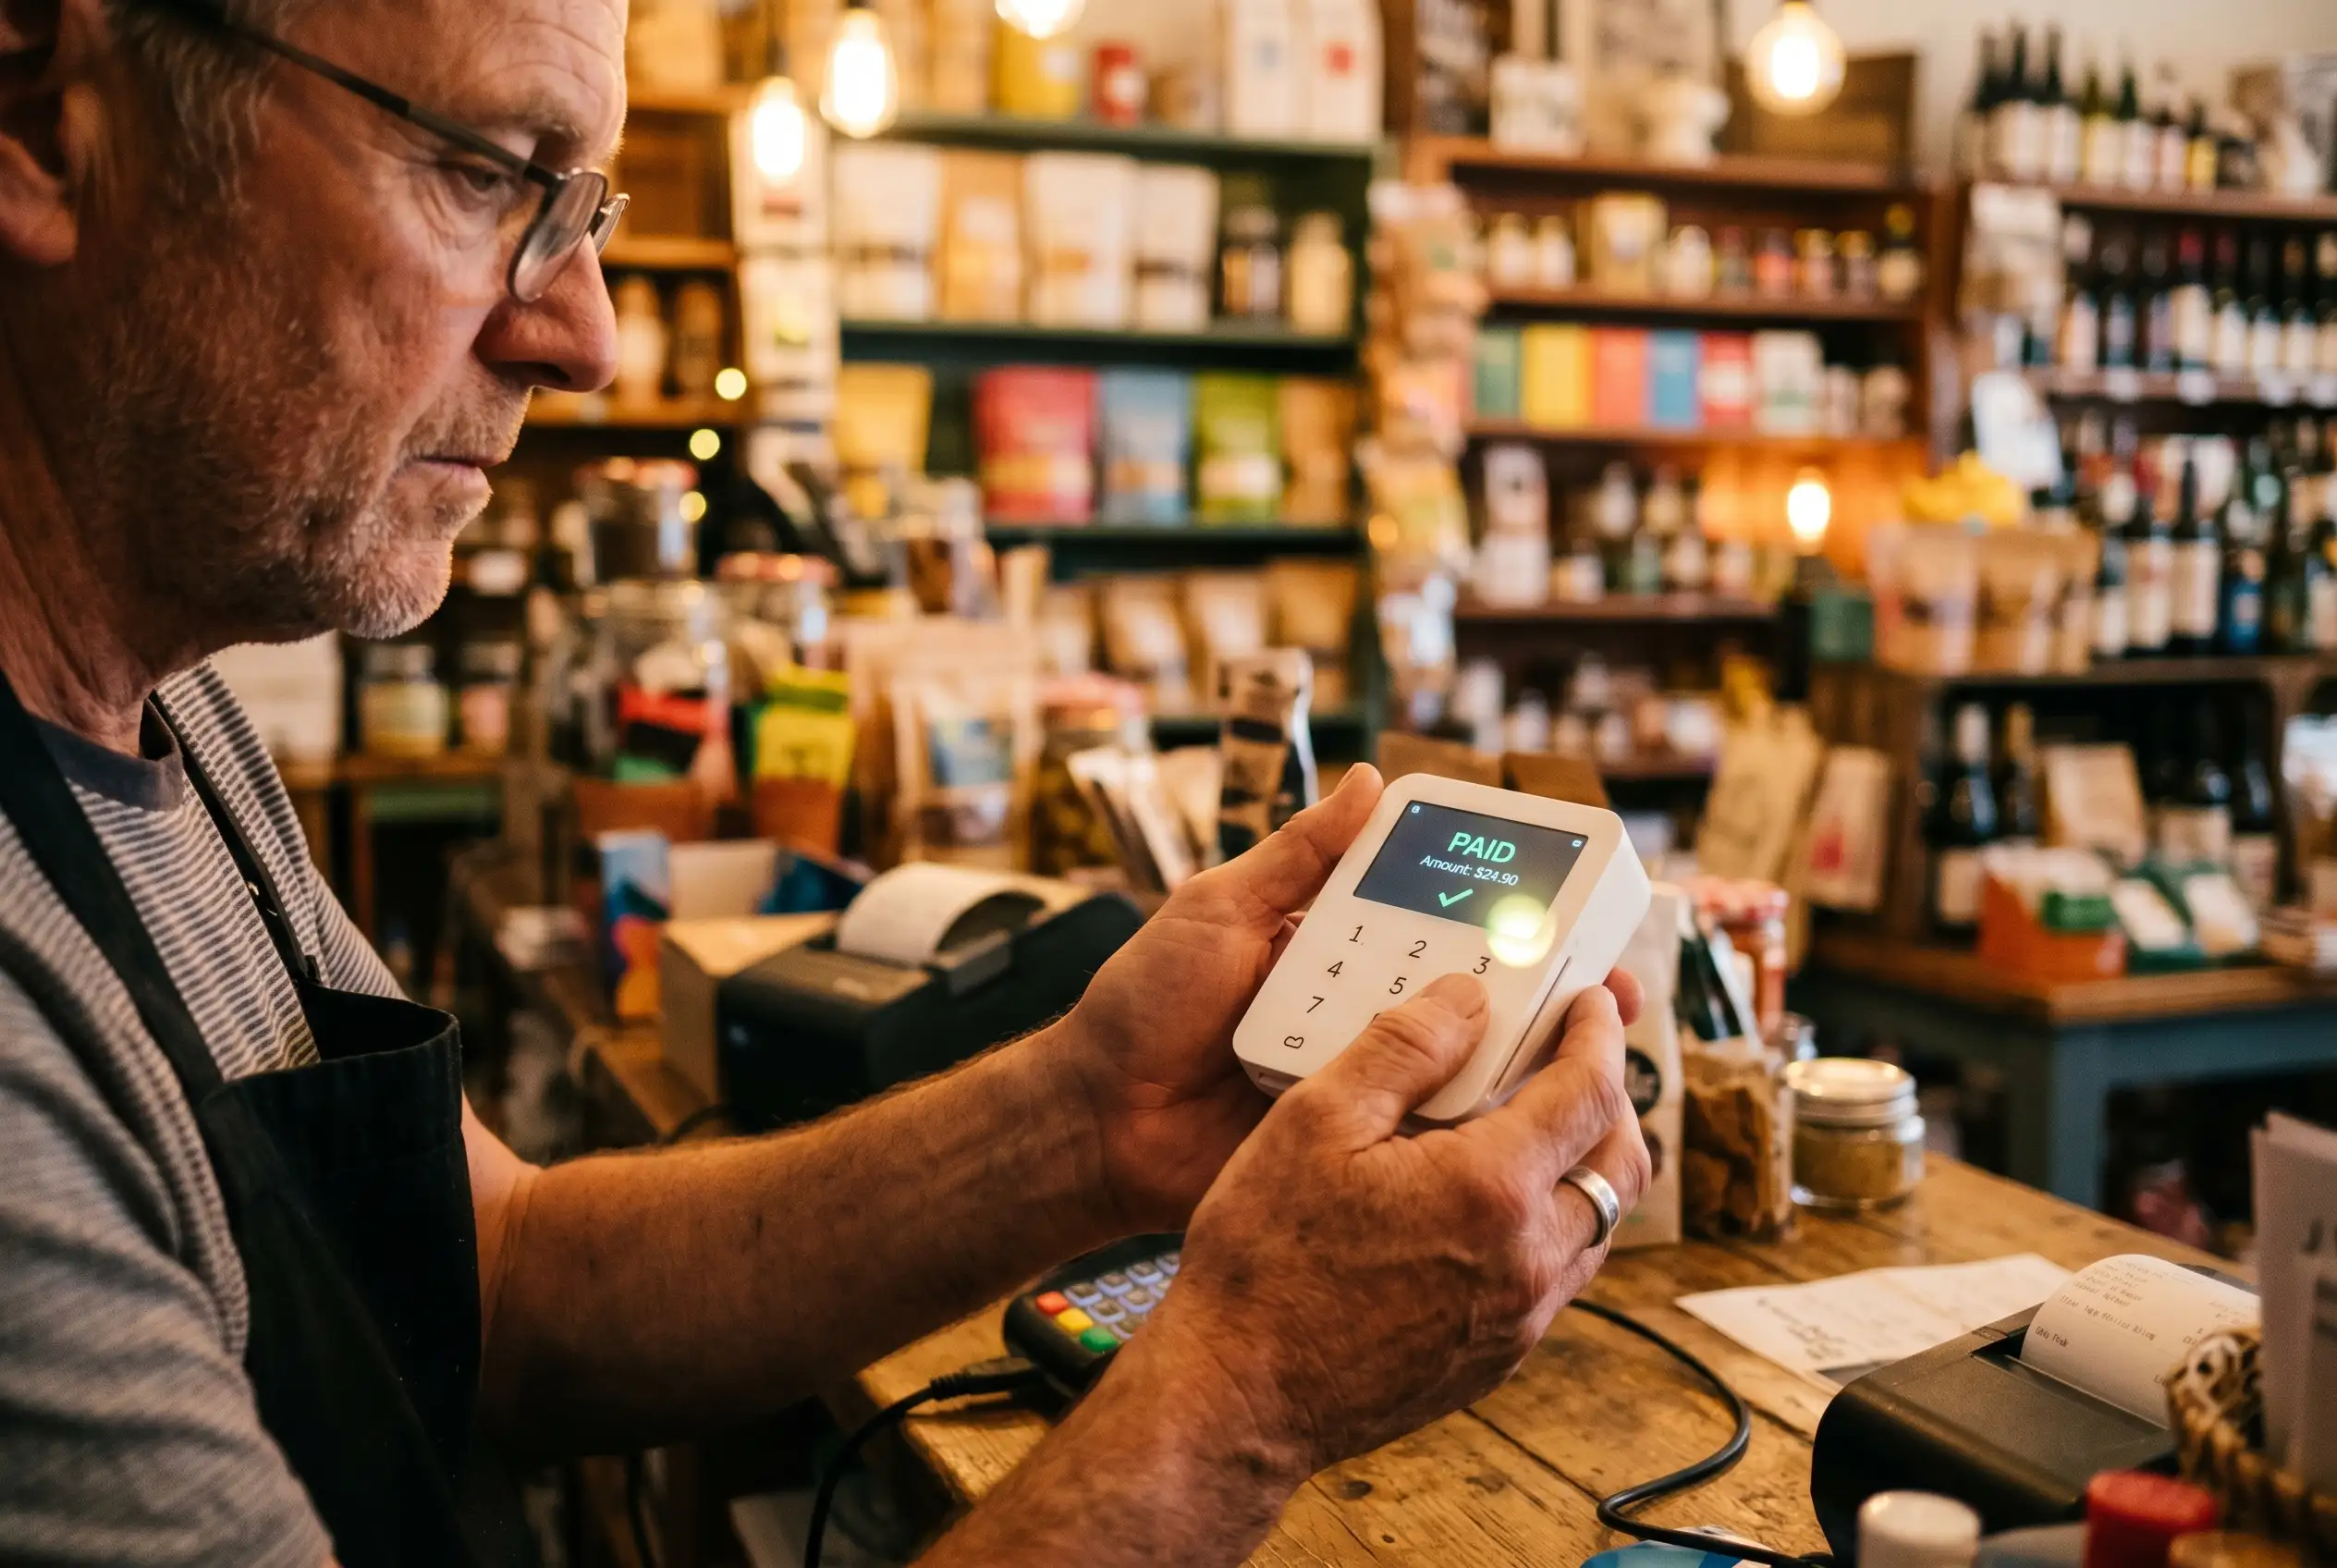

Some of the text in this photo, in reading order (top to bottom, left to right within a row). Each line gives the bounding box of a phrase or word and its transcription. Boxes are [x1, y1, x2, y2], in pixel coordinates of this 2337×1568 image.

[1447, 831, 1516, 864] PAID
[1419, 854, 1519, 886] Amount: $24.90
[1349, 925, 1490, 974] 1 2 3
[1327, 961, 1407, 994] 4 5
[1306, 996, 1325, 1013] 7
